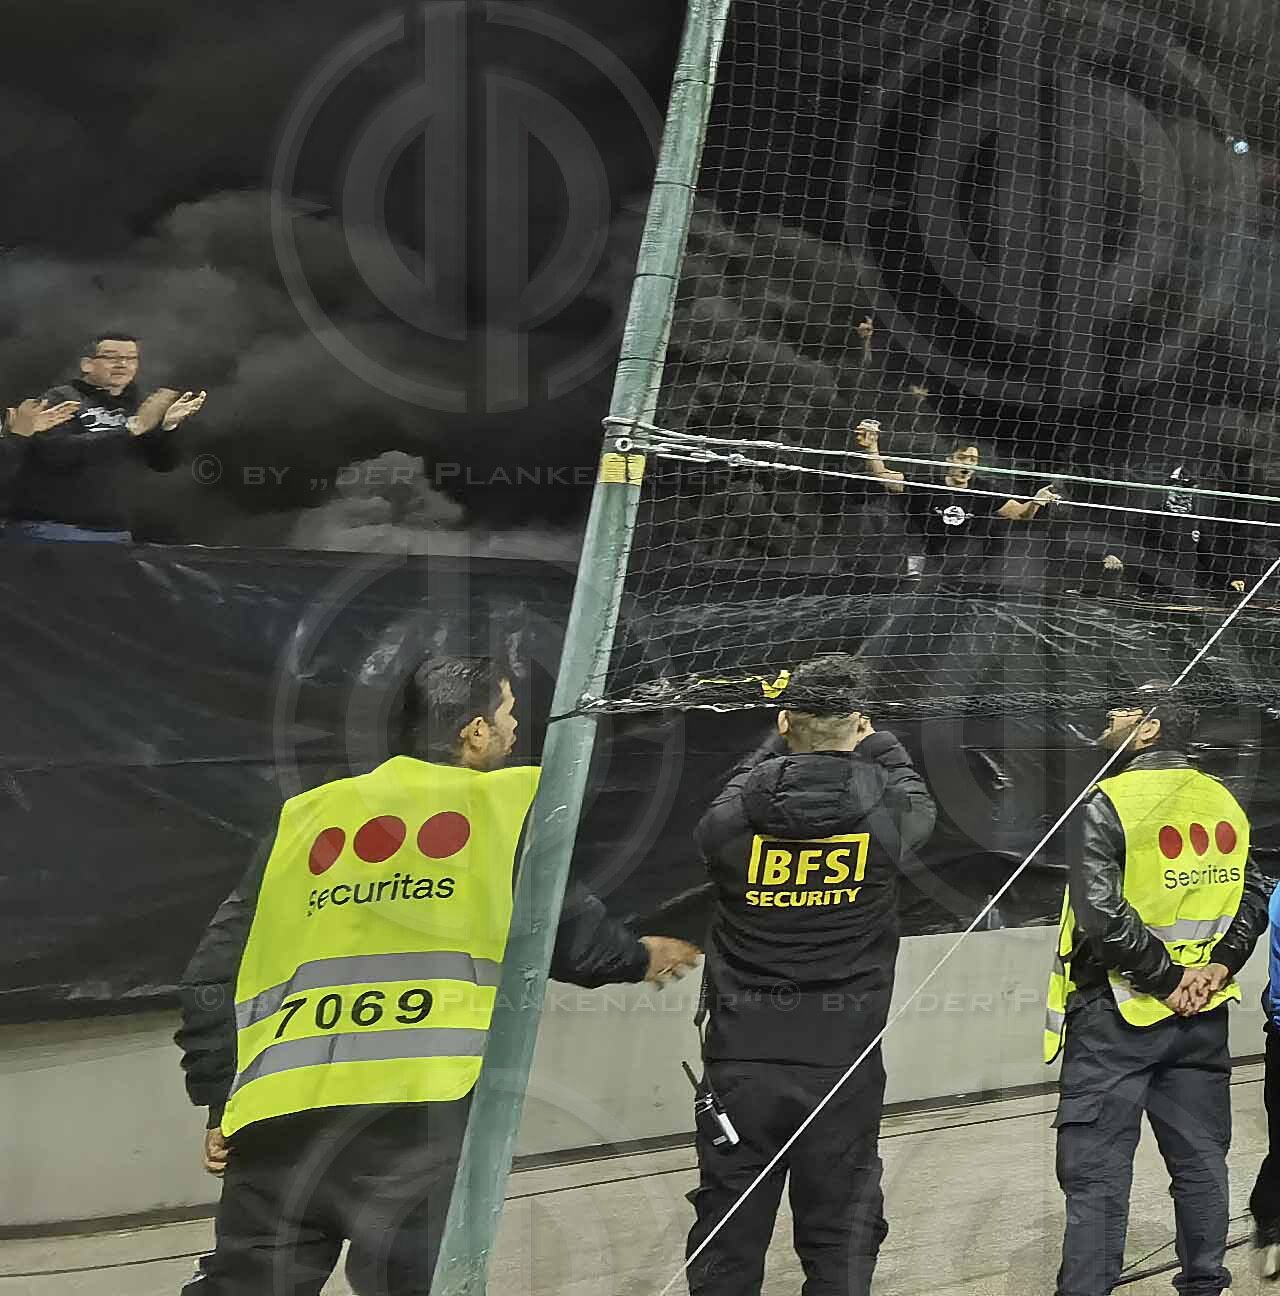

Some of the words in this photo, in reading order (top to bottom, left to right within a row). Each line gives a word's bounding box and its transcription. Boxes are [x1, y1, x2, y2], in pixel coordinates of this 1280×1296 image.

[761, 848, 851, 885] BFS
[745, 886, 862, 908] SECURITY
[274, 987, 433, 1039] 7069
